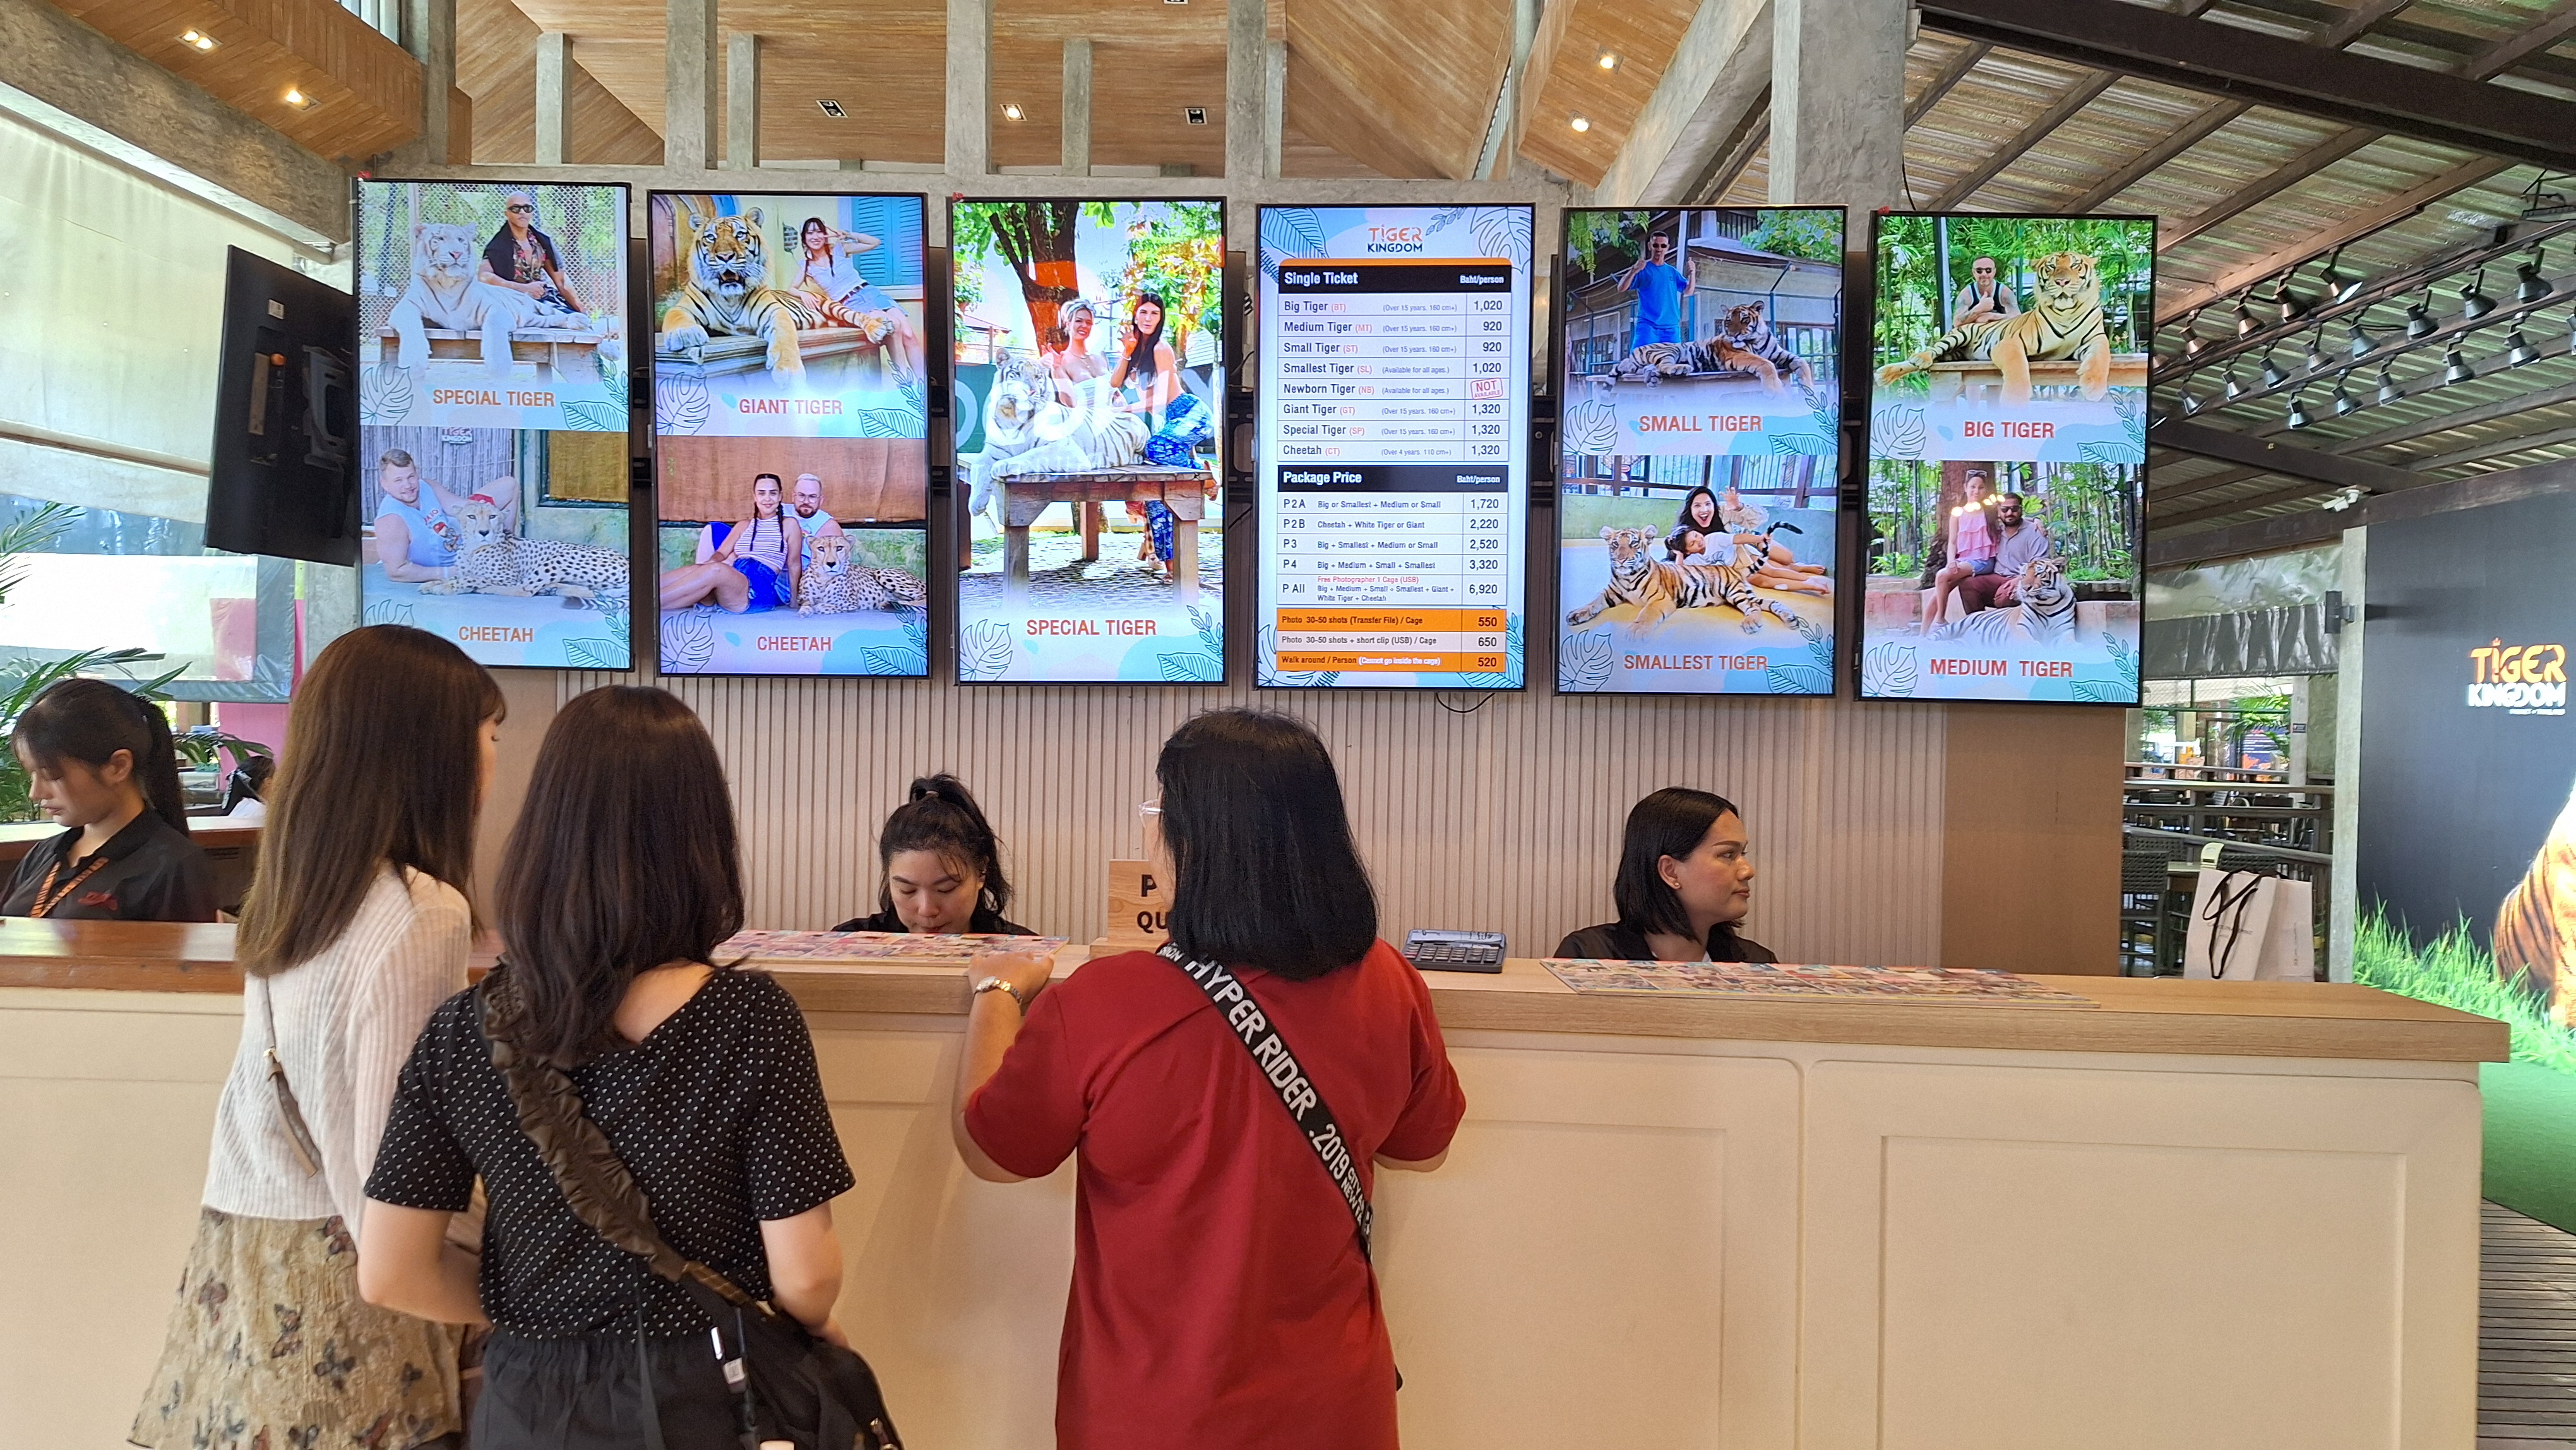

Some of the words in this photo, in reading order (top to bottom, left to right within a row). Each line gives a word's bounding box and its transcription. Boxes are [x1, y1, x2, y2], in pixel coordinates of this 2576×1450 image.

[1368, 224, 1422, 242] TIGER
[1368, 243, 1422, 253] KINGDOM
[1284, 272, 1321, 287] Single
[1323, 272, 1358, 284] Ticket
[1460, 275, 1504, 284] Baht/person
[1284, 301, 1299, 313] Big
[1303, 301, 1328, 313] Tiger
[1332, 304, 1346, 313] (BT)
[1474, 301, 1503, 312] 1,020
[1284, 322, 1324, 332] Medium
[1327, 322, 1352, 333] Tiger
[1356, 325, 1373, 333] (MT)
[1483, 321, 1502, 331] 920
[1284, 343, 1312, 352] Small
[1315, 343, 1340, 354] Tiger
[1343, 345, 1358, 354] (ST)
[1483, 342, 1501, 352] 920
[1284, 363, 1327, 373] Smallest
[1329, 363, 1354, 376] Tiger
[1357, 366, 1373, 374] (SL)
[1473, 362, 1501, 374] 1,020
[1284, 384, 1327, 394] Newborn
[1331, 384, 1356, 397] Tiger
[1358, 386, 1374, 396] (NB)
[1476, 380, 1497, 392] NOT
[433, 389, 501, 406] SPECIAL
[507, 391, 555, 407] TIGER
[739, 399, 789, 414] GIANT
[794, 400, 844, 415] TIGER
[1284, 404, 1309, 414] Giant
[1312, 404, 1337, 417] Tiger
[1472, 404, 1501, 416] 1,320
[1472, 424, 1500, 436] 1,320
[1640, 416, 1702, 432] SMALL
[1709, 416, 1762, 432] TIGER
[1964, 421, 1995, 438] BIG
[2001, 421, 2055, 439] TIGER
[1283, 425, 1318, 438] Special
[1322, 425, 1347, 438] Tiger
[1349, 427, 1365, 436] (SP)
[1283, 445, 1321, 455] Cheetah
[1325, 447, 1340, 456] (CT)
[1472, 445, 1500, 457] 1,320
[1284, 472, 1330, 484] Package
[1333, 471, 1362, 483] Price
[1457, 475, 1500, 484] Baht/person
[1318, 501, 1329, 509] Big
[1470, 498, 1499, 510] 1,720
[1470, 519, 1498, 530] 2,220
[1318, 541, 1328, 549] Big
[1470, 539, 1498, 551] 2,520
[1318, 561, 1328, 570] Big
[1469, 560, 1498, 571] 3,320
[1469, 584, 1498, 595] 6,920
[1350, 616, 1381, 625] (Transfer
[1383, 617, 1398, 625] File)
[1405, 617, 1422, 625] Cage
[1478, 616, 1497, 626] 550
[1027, 619, 1100, 636] SPECIAL
[1106, 619, 1157, 636] TIGER
[458, 626, 534, 642] CHEETAH
[757, 637, 832, 652] CHEETAH
[1377, 637, 1389, 645] clip
[1392, 637, 1412, 645] (USB)
[1419, 637, 1436, 645] Cage
[1478, 637, 1497, 647] 650
[1477, 657, 1497, 668] 520
[1623, 655, 1713, 671] SMALLEST
[1719, 656, 1768, 671] TIGER
[2469, 638, 2568, 683] TIGER
[1930, 659, 2008, 676] MEDIUM
[2019, 661, 2073, 678] TIGER
[2467, 682, 2567, 707] KINGDOM
[1184, 955, 1266, 1045] HYPER
[1253, 1033, 1318, 1122] RIDER
[1348, 1168, 1362, 1195] CITY
[1341, 1177, 1357, 1210] NEW
